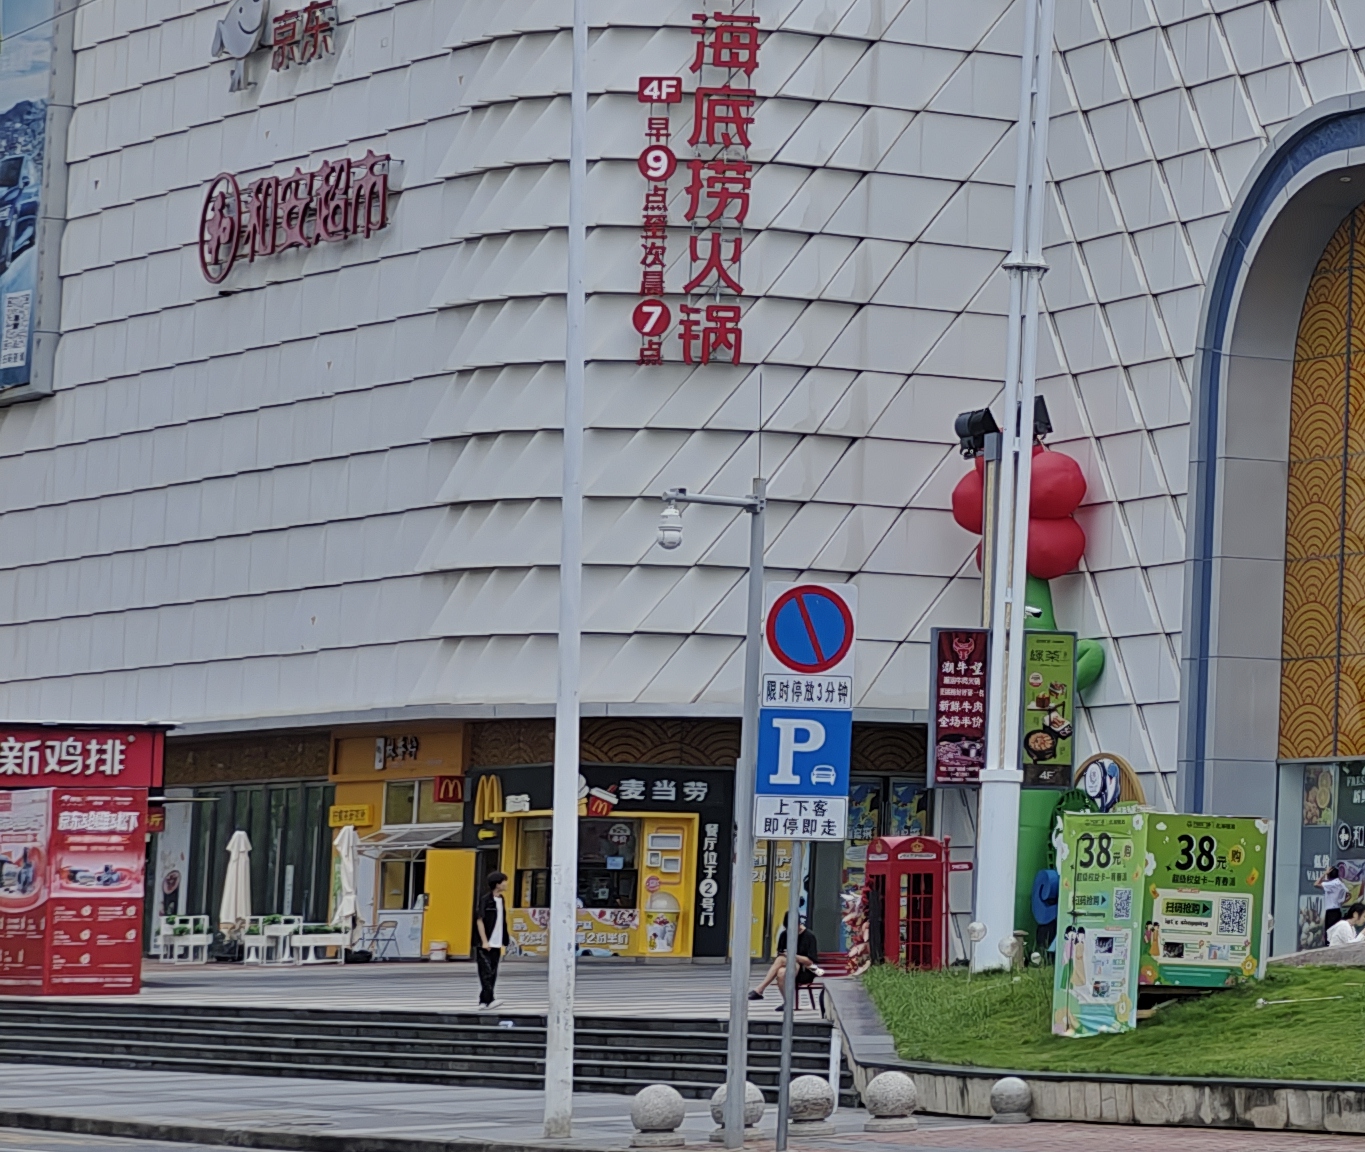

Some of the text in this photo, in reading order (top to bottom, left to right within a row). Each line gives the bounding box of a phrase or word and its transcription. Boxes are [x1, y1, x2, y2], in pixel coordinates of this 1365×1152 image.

[271, 0, 338, 72] 京东
[643, 79, 678, 100] 4F
[679, 11, 761, 366] 海底捞火锅
[247, 149, 390, 262] 和安超市
[766, 680, 848, 704] 限时停放3分钟
[939, 700, 983, 713] 新鲜牛肉
[938, 715, 983, 728] 全场半价
[0, 736, 126, 776] 新鸡排
[769, 718, 826, 785] P
[1039, 770, 1056, 780] 4F
[619, 779, 708, 801] 麦当劳
[774, 799, 828, 817] 上下客
[764, 818, 837, 836] 即停即走
[1175, 834, 1216, 872] 38
[1306, 869, 1328, 881] VAL
[1165, 901, 1200, 915] 扫码抢购
